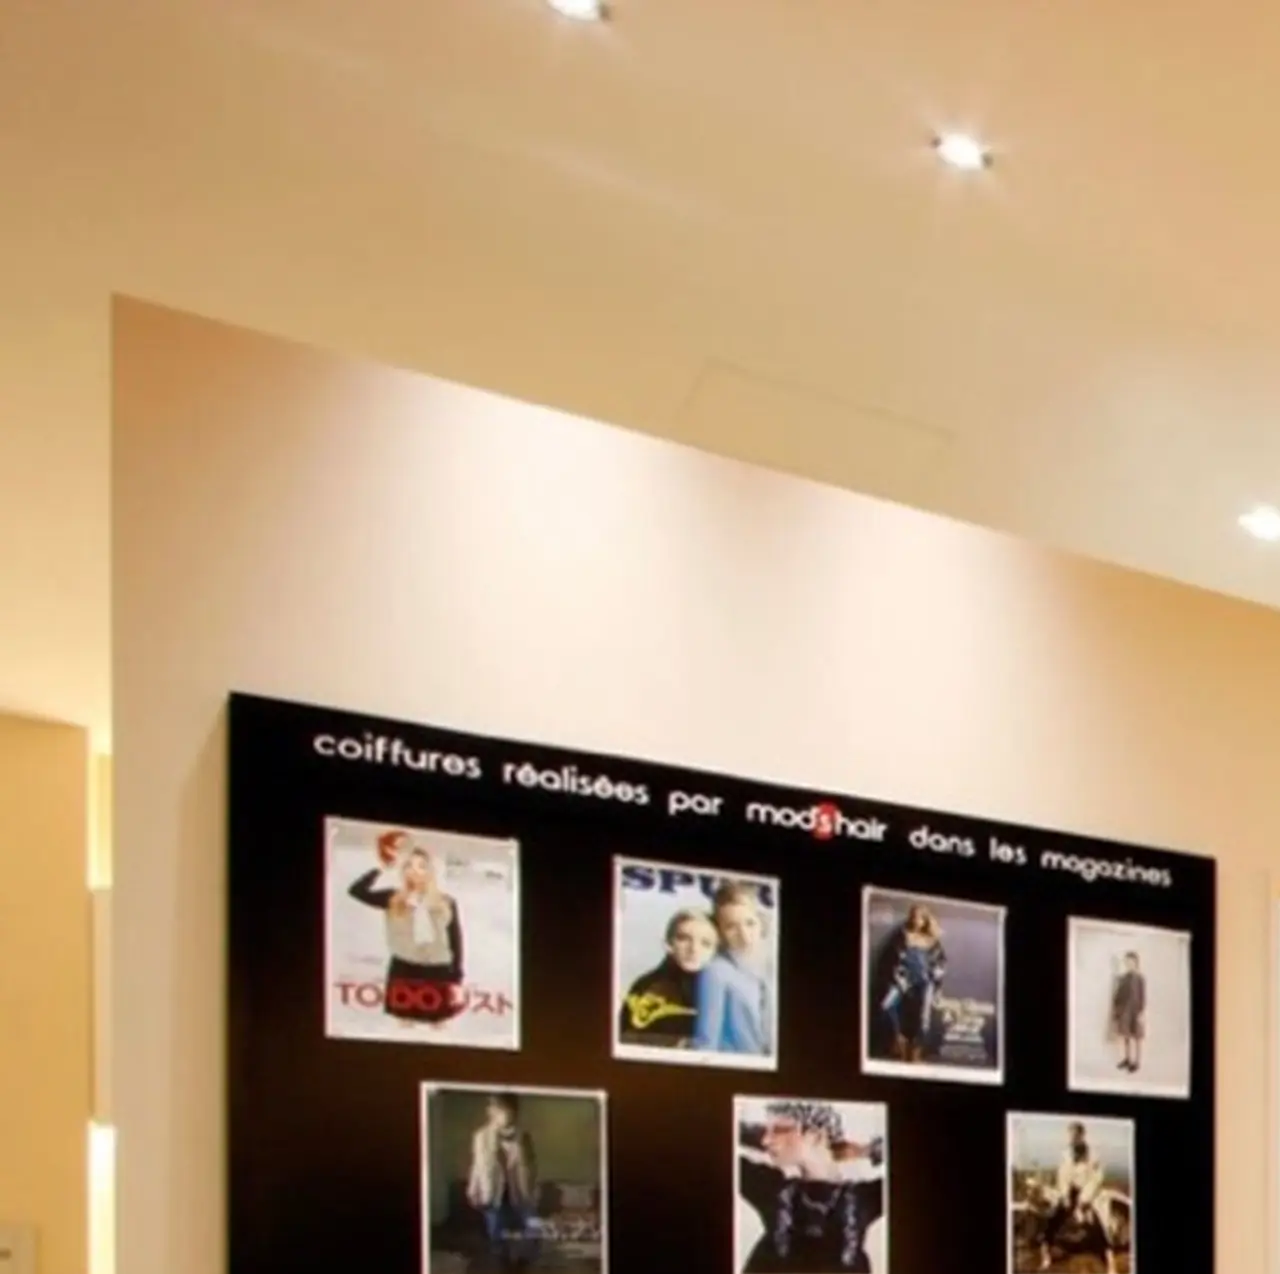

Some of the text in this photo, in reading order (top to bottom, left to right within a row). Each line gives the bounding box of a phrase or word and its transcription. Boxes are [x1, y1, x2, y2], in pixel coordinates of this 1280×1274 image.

[313, 732, 483, 778] coiffures
[502, 760, 650, 805] réalisées
[667, 789, 724, 816] par
[908, 824, 976, 857] dans
[989, 836, 1028, 867] les
[1039, 848, 1173, 888] magazines
